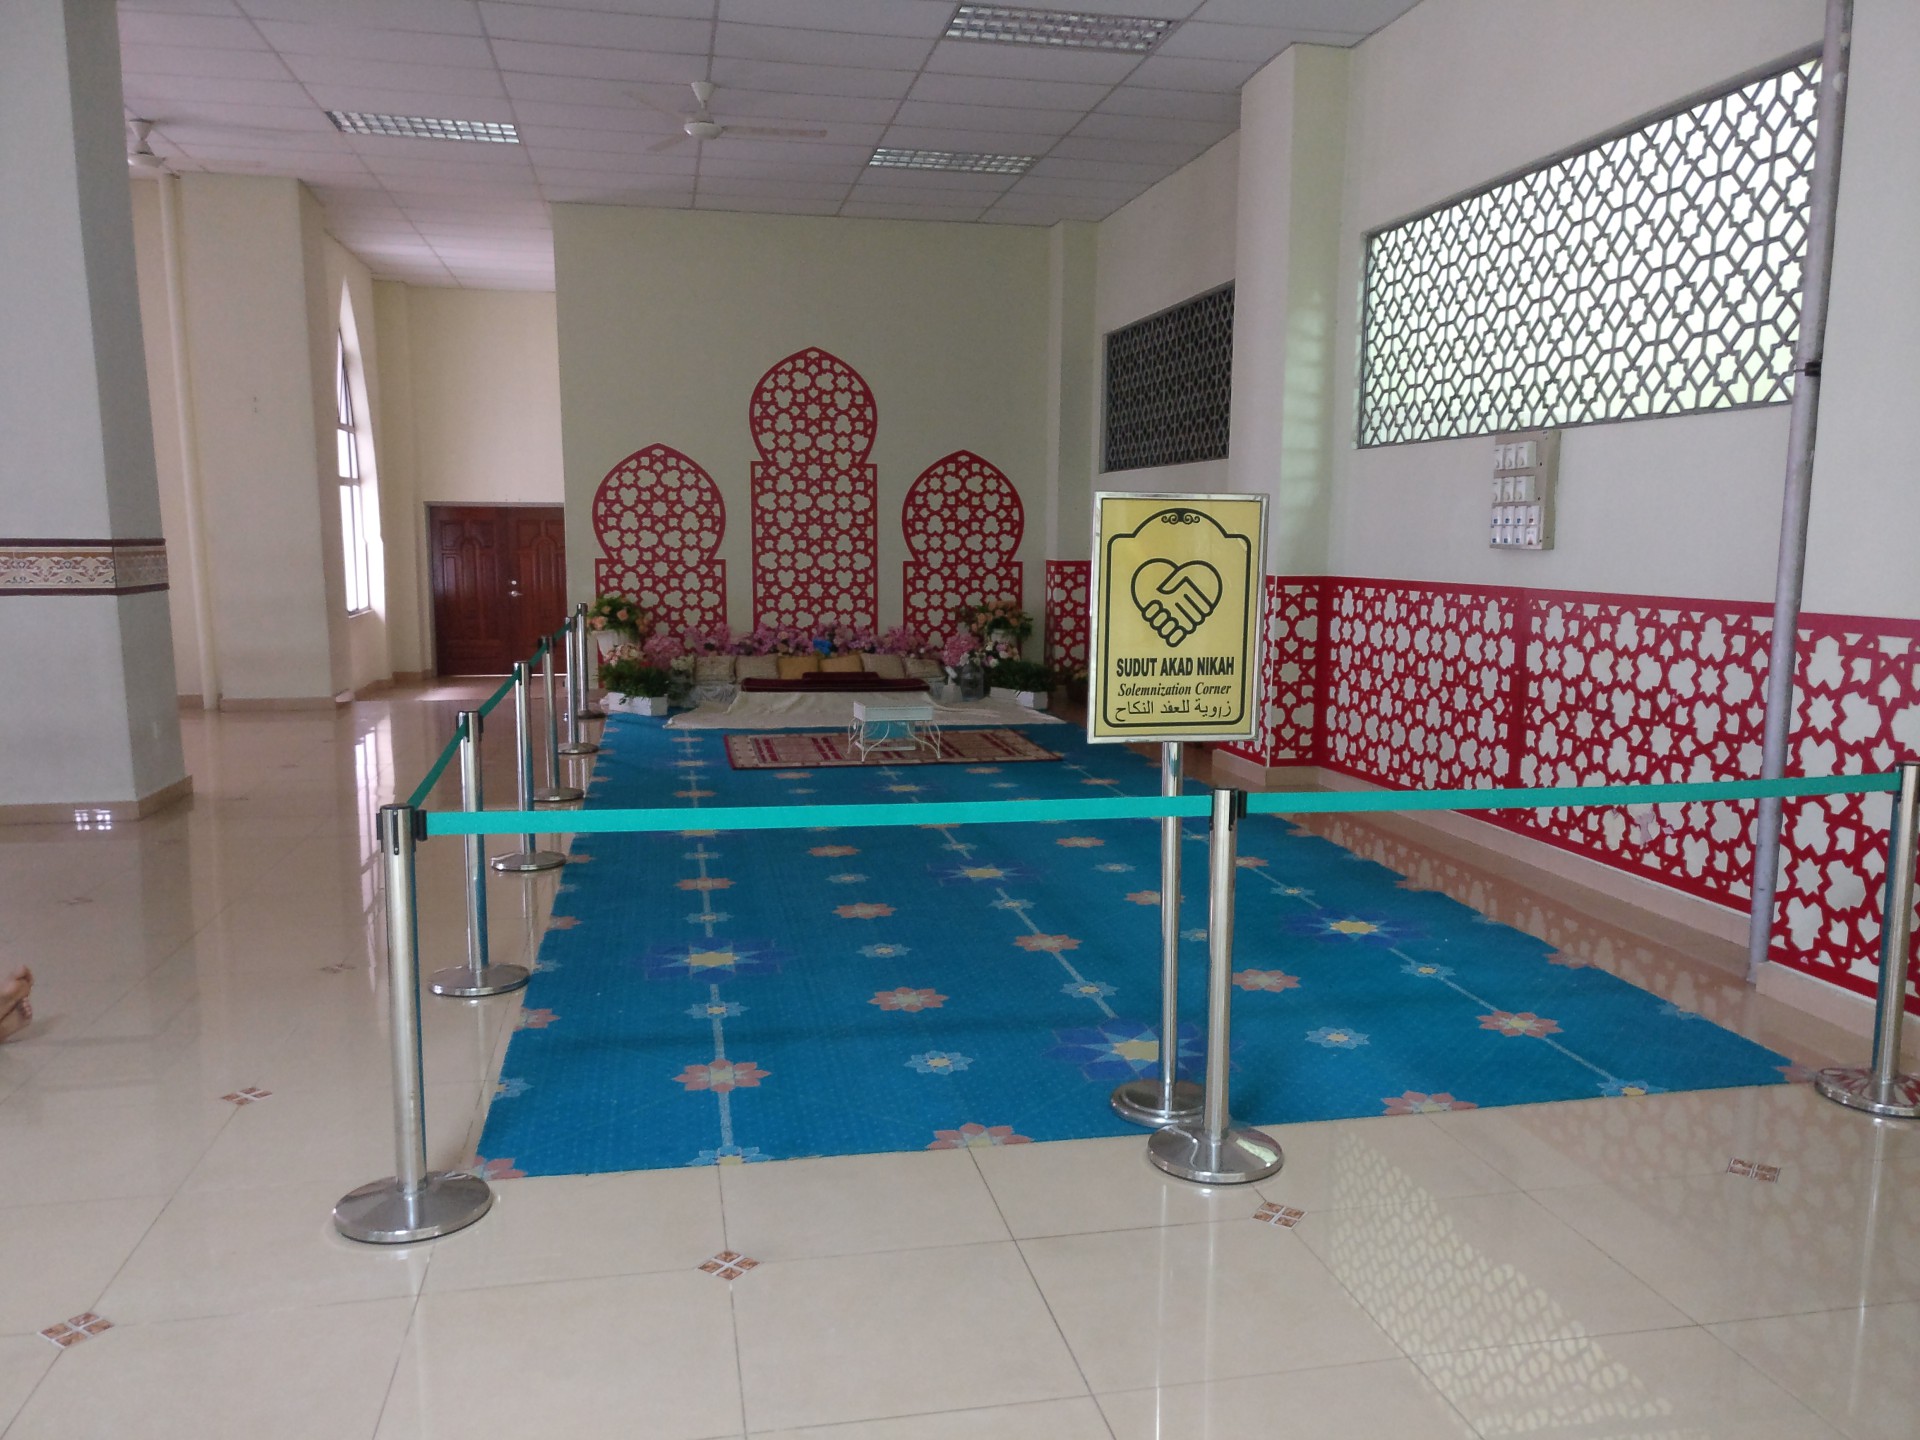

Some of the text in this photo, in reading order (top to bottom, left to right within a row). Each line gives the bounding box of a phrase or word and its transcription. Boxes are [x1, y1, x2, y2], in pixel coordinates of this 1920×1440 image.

[1116, 656, 1235, 677] SUDUT AKAD NIKAH
[1117, 681, 1232, 697] Solemnization Corner
[1115, 699, 1154, 722] النكاح
[1194, 698, 1232, 719] زاوية
